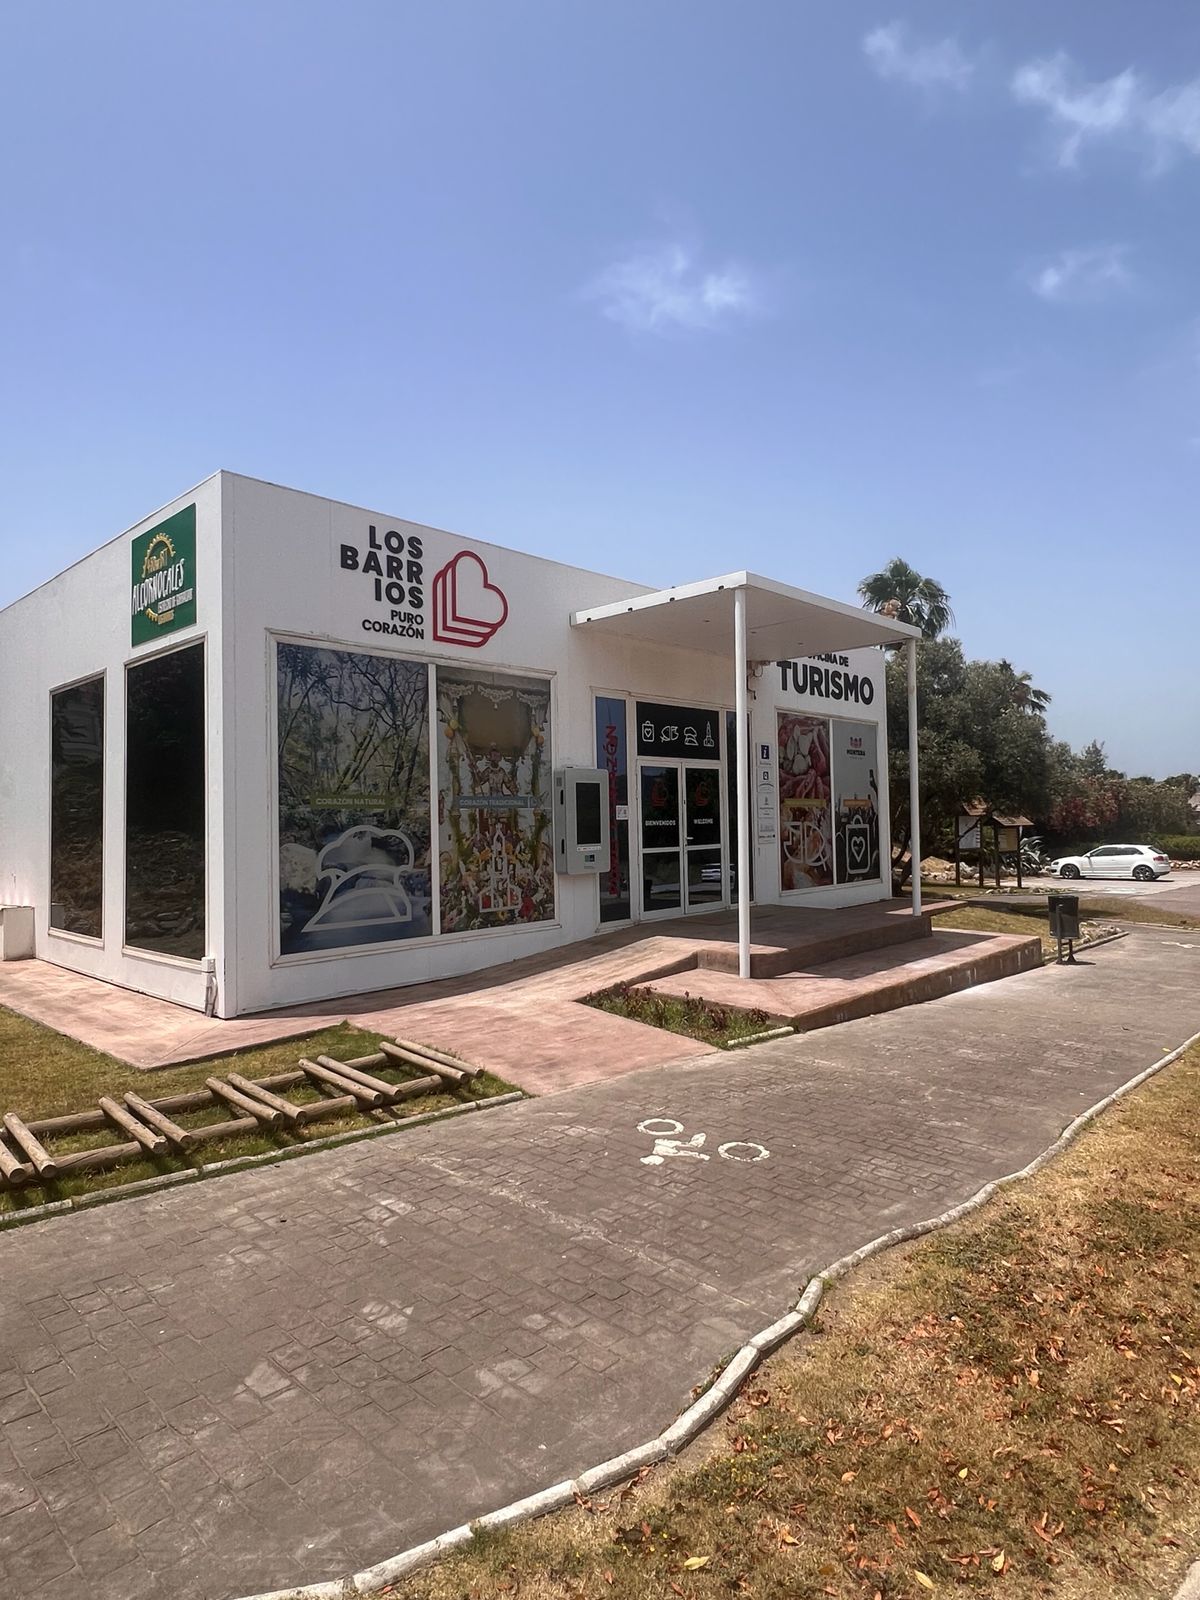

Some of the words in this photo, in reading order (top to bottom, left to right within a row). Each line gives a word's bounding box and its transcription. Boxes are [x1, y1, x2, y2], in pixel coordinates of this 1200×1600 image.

[369, 525, 424, 560] LOS
[340, 544, 424, 586] BARR
[374, 578, 424, 609] IOS
[361, 619, 425, 640] CORAZÓN
[390, 609, 424, 625] PURO
[839, 655, 849, 667] DE
[776, 660, 874, 705] TURISMO
